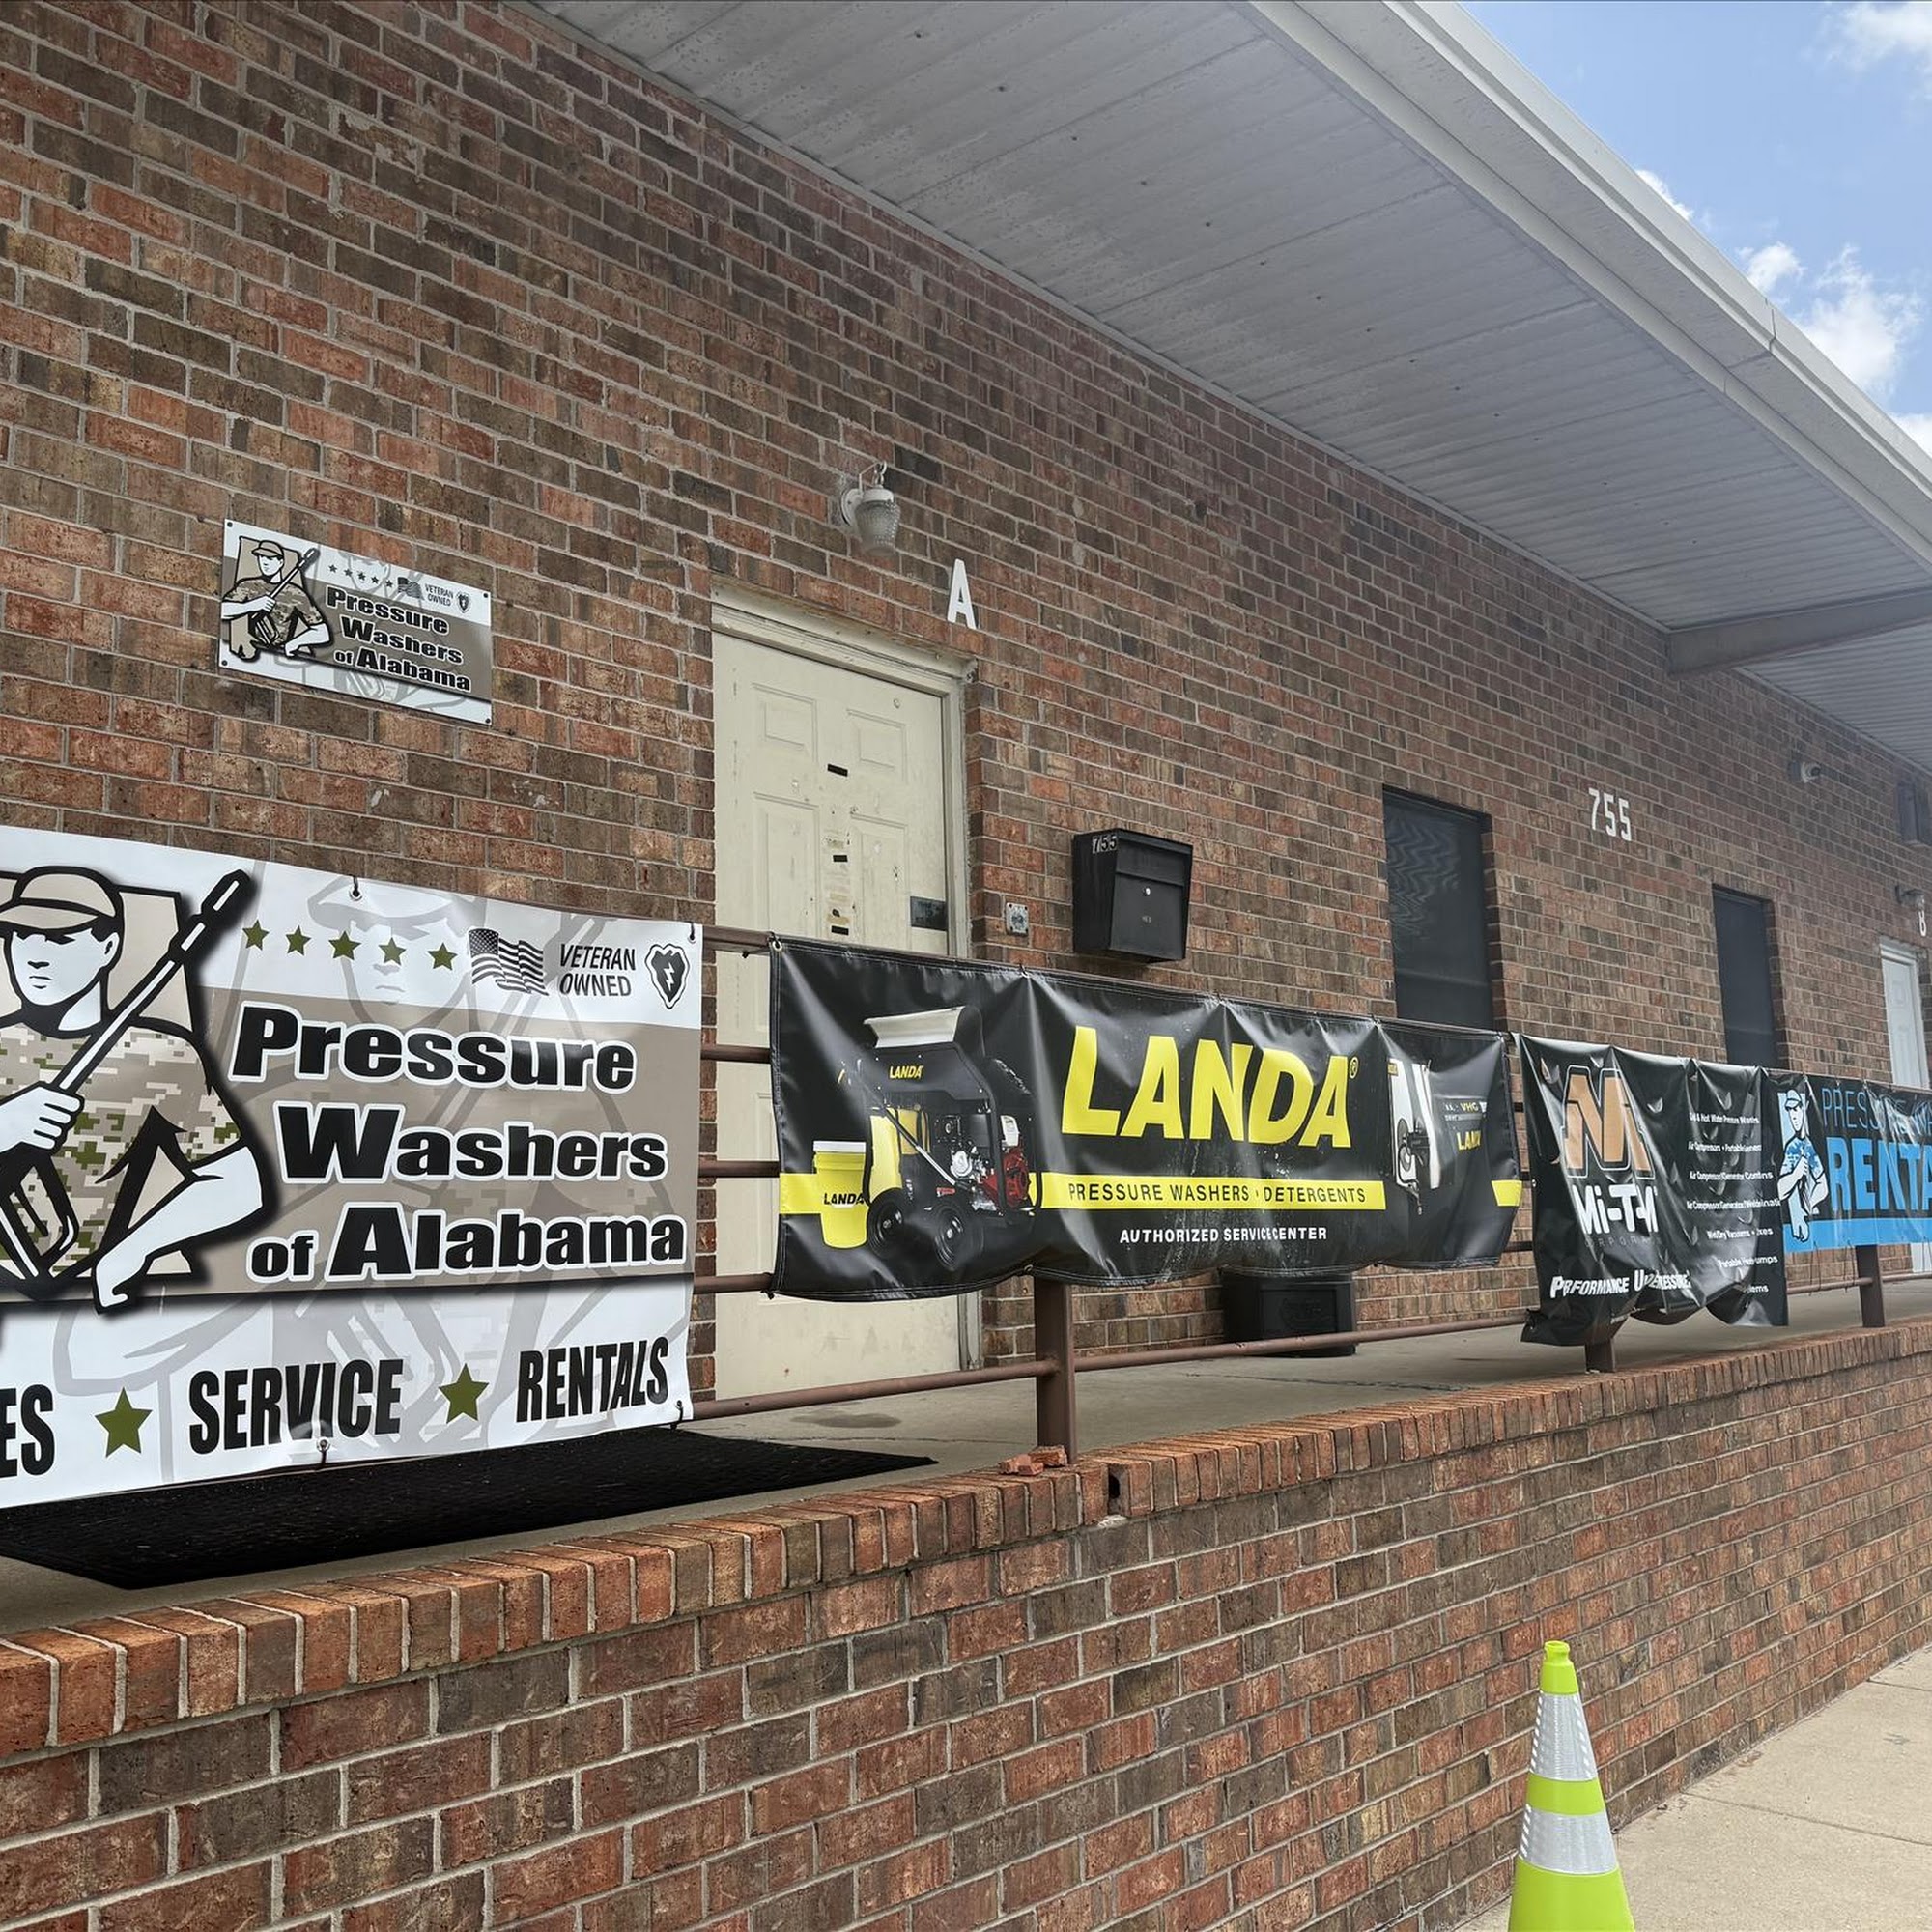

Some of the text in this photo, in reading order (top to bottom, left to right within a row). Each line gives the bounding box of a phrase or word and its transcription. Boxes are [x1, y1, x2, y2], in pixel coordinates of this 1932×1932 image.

[425, 583, 454, 599] VETERAN
[428, 593, 451, 607] OWNED
[947, 558, 976, 630] A
[327, 586, 448, 635] Pressure
[340, 617, 463, 664] Washers
[335, 648, 471, 692] of Alabama
[1588, 787, 1632, 841] 755
[1093, 836, 1117, 854] 755
[560, 943, 636, 971] VETERAN
[560, 973, 631, 997] OWNED
[230, 1004, 636, 1091] Pressure
[890, 1065, 924, 1079] LANDA
[276, 1104, 667, 1180] Washers
[824, 1193, 865, 1205] LANDA
[1069, 1182, 1366, 1203] PRESSURE WASHERS DETERGENTS
[251, 1206, 685, 1279] of Alabama
[1120, 1228, 1218, 1243] AUTHORIZED
[1272, 1227, 1327, 1240] CENTER
[189, 1359, 403, 1454] SERVICE
[517, 1337, 669, 1423] RENTALS
